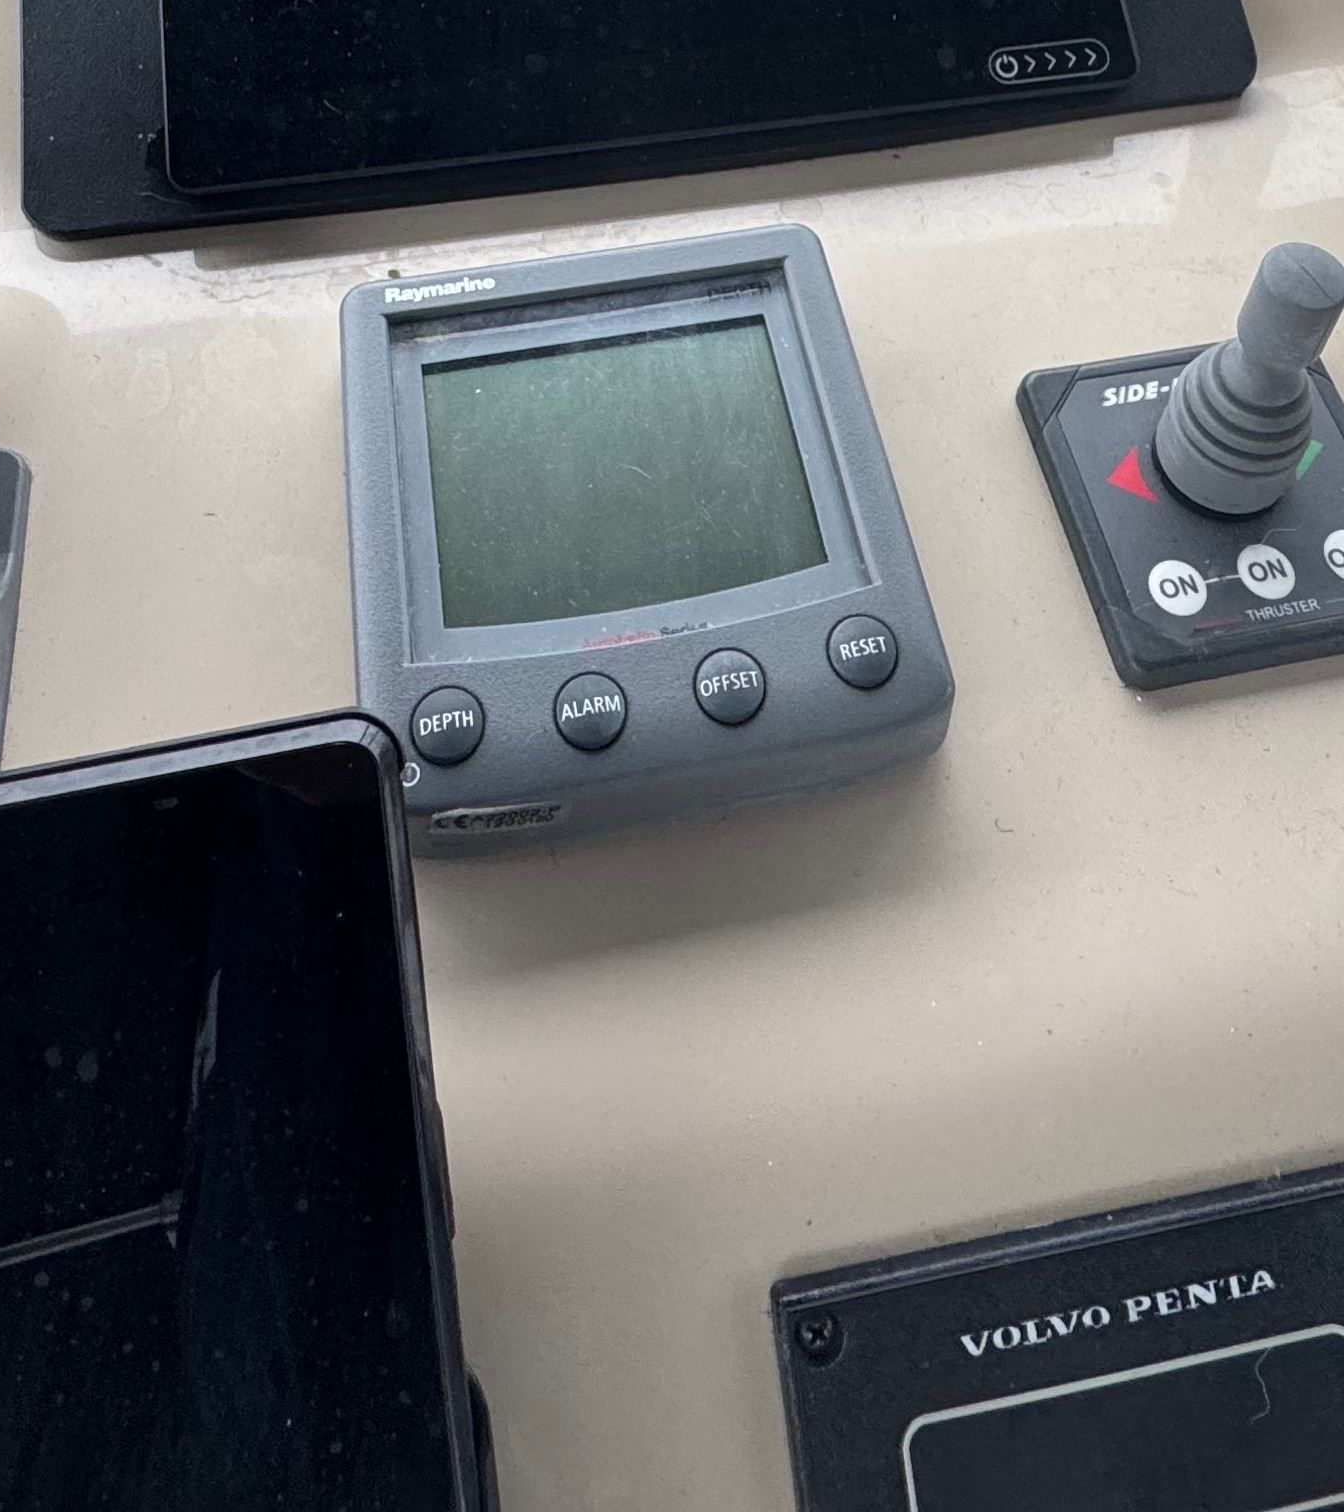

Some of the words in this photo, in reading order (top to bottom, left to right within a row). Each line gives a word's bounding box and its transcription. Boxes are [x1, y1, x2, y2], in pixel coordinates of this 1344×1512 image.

[384, 276, 496, 303] Raymarine
[1102, 377, 1179, 408] SIDE-
[1158, 574, 1200, 599] ON
[1247, 557, 1289, 583] ON
[1244, 598, 1322, 622] THRUSTER
[839, 636, 887, 661] RESET
[699, 670, 759, 697] OFFSET
[560, 694, 622, 722] ALARM
[419, 709, 475, 737] DEPTH
[959, 1305, 1112, 1357] VOLVO
[1123, 1269, 1277, 1322] PENTA
